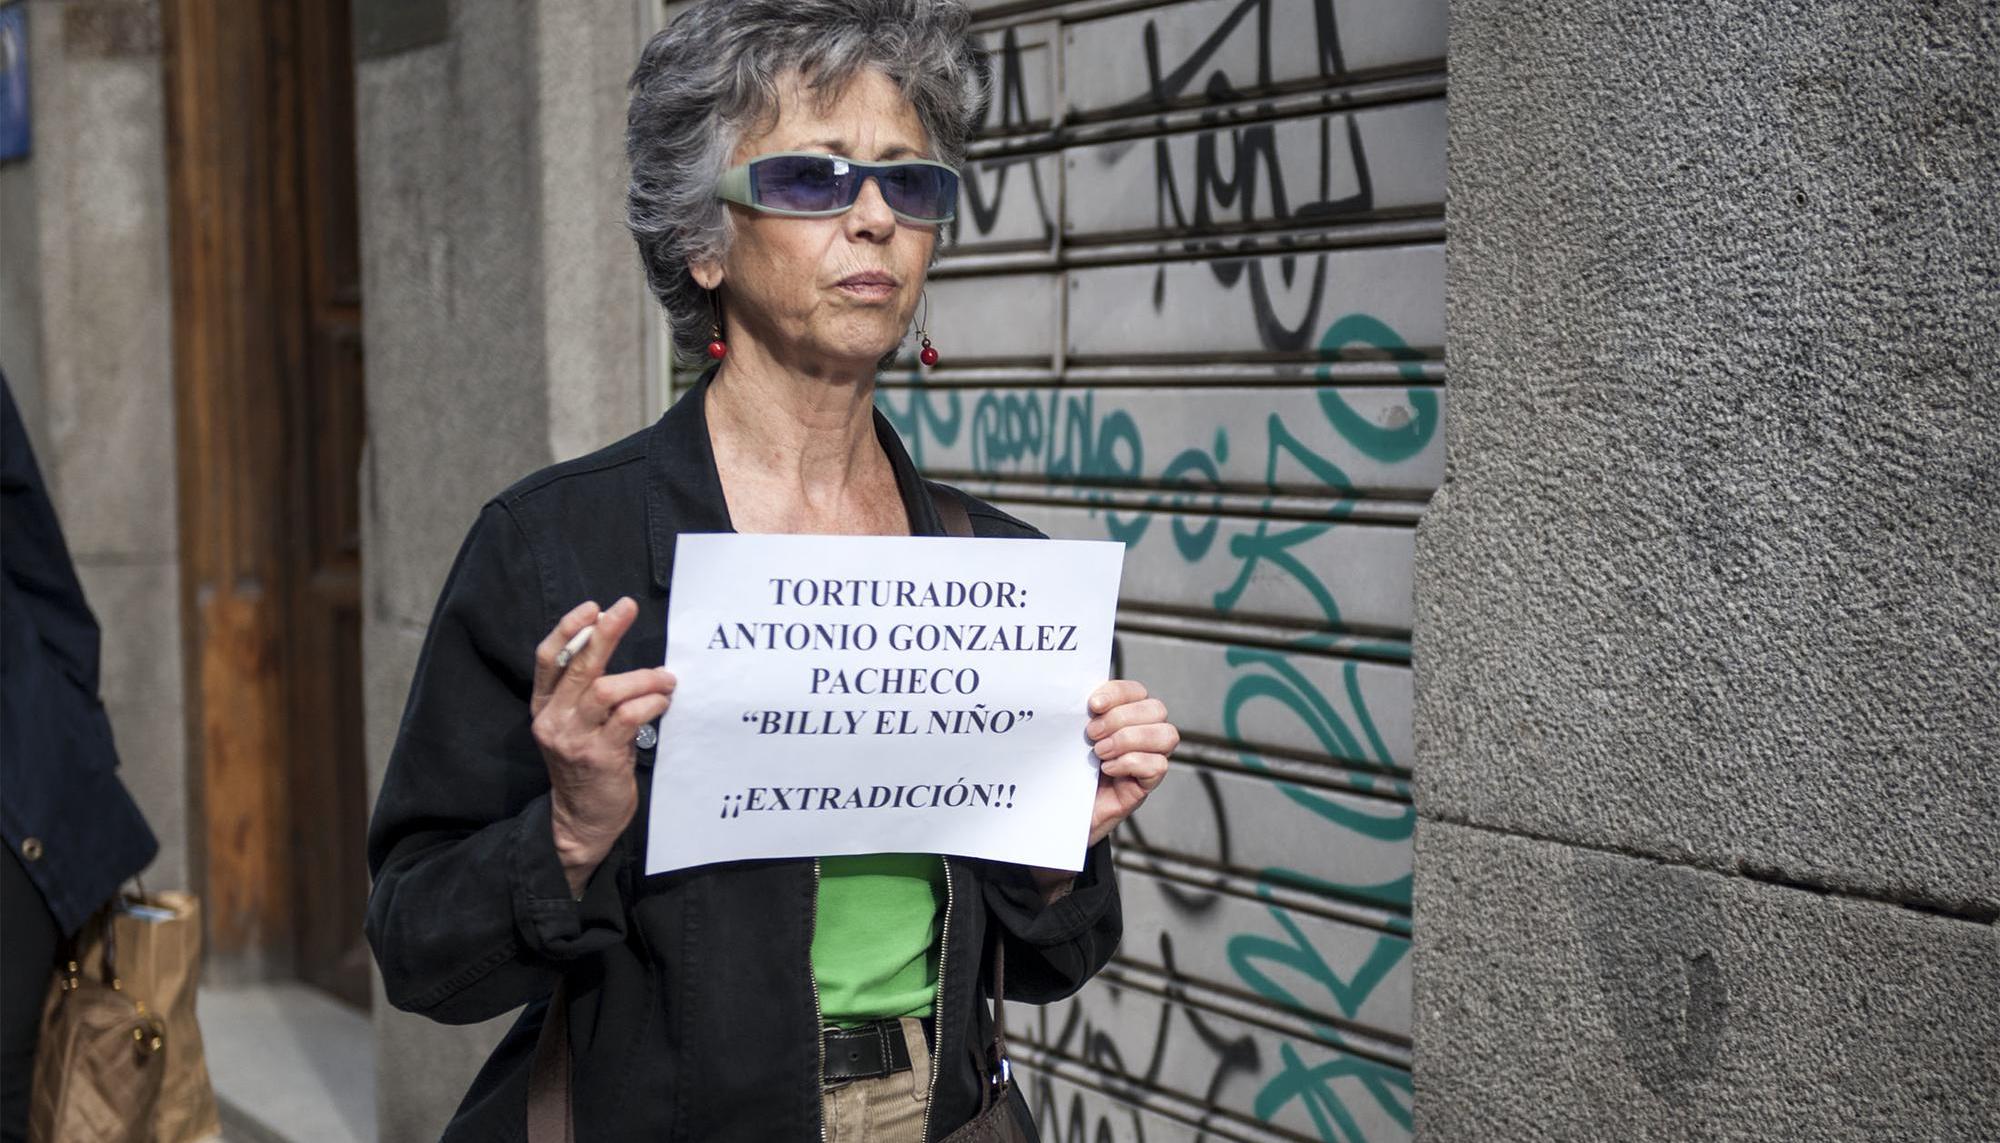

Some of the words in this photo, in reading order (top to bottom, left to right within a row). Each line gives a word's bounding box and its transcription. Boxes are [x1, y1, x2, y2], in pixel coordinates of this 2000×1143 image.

[770, 579, 1027, 608] TORTURADOR:
[708, 623, 878, 651] ANTONIO
[889, 624, 1077, 651] GONZALEZ
[811, 668, 980, 695] PACHECO
[742, 710, 867, 735] “BILLY
[874, 710, 918, 735] EL
[927, 703, 1034, 735] NIÑO”
[720, 777, 1017, 820] ¡¡EXTRADICIÓN!!
